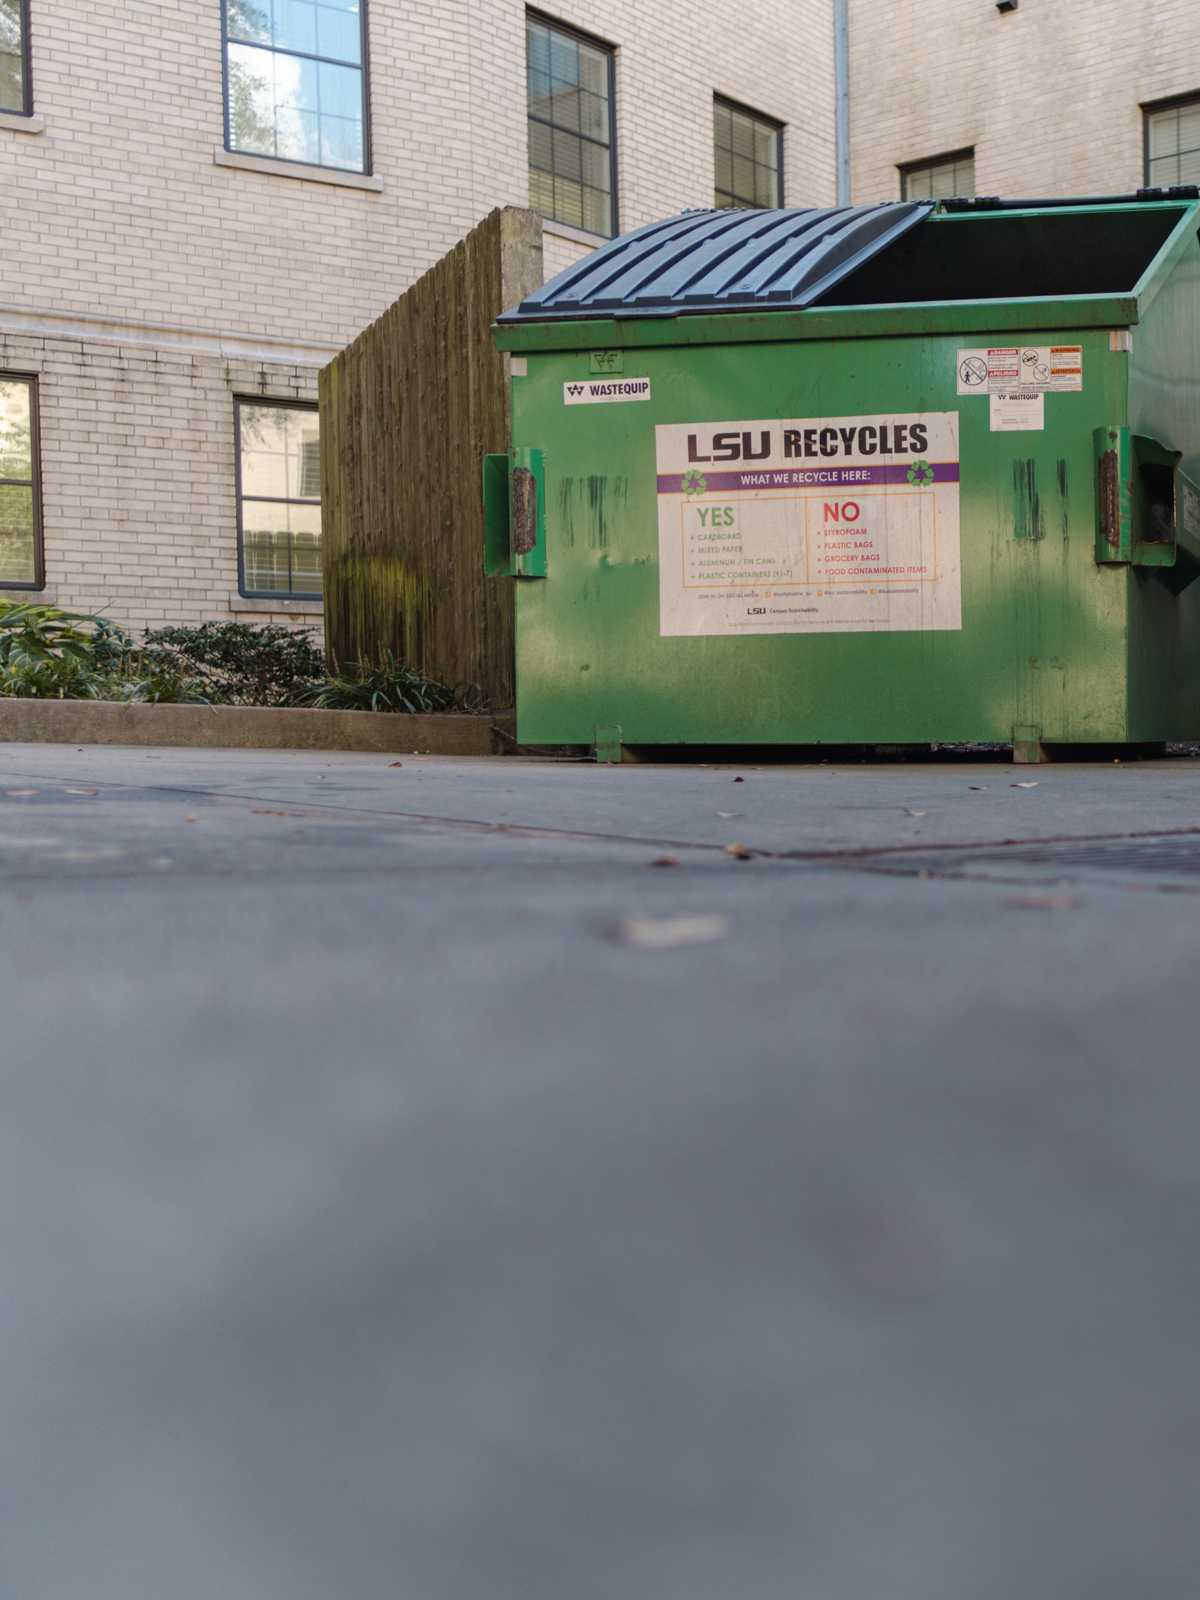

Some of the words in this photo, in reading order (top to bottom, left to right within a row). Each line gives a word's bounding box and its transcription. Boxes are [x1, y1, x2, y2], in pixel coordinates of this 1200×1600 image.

[590, 382, 649, 396] WASTEQUIP
[1009, 393, 1039, 401] WASTEQUIP
[687, 430, 771, 462] LSU
[783, 423, 928, 458] RECYCLES
[740, 474, 769, 486] WHAT
[774, 473, 790, 484] WE
[793, 471, 838, 483] RECYCLE
[841, 470, 871, 481] HERE:
[823, 500, 861, 522] NO
[696, 506, 735, 528] YES
[697, 533, 743, 541] CARDBOARD
[824, 528, 868, 537] STYROFOAM
[698, 546, 720, 554] MIXED
[722, 545, 743, 553] PAPER
[824, 541, 853, 550] PLASTIC
[854, 540, 873, 549] BAGS
[698, 558, 736, 567] ALUMINUM
[755, 557, 776, 565] CANS
[825, 554, 859, 563] GROCERY
[861, 553, 880, 562] BAGS
[698, 571, 727, 579] PLASTIC
[728, 569, 772, 578] CONTAINERS
[824, 567, 846, 576] FOOD
[848, 566, 905, 575] CONTAMINATED
[906, 565, 928, 574] ITEMS
[747, 607, 766, 615] LSU
